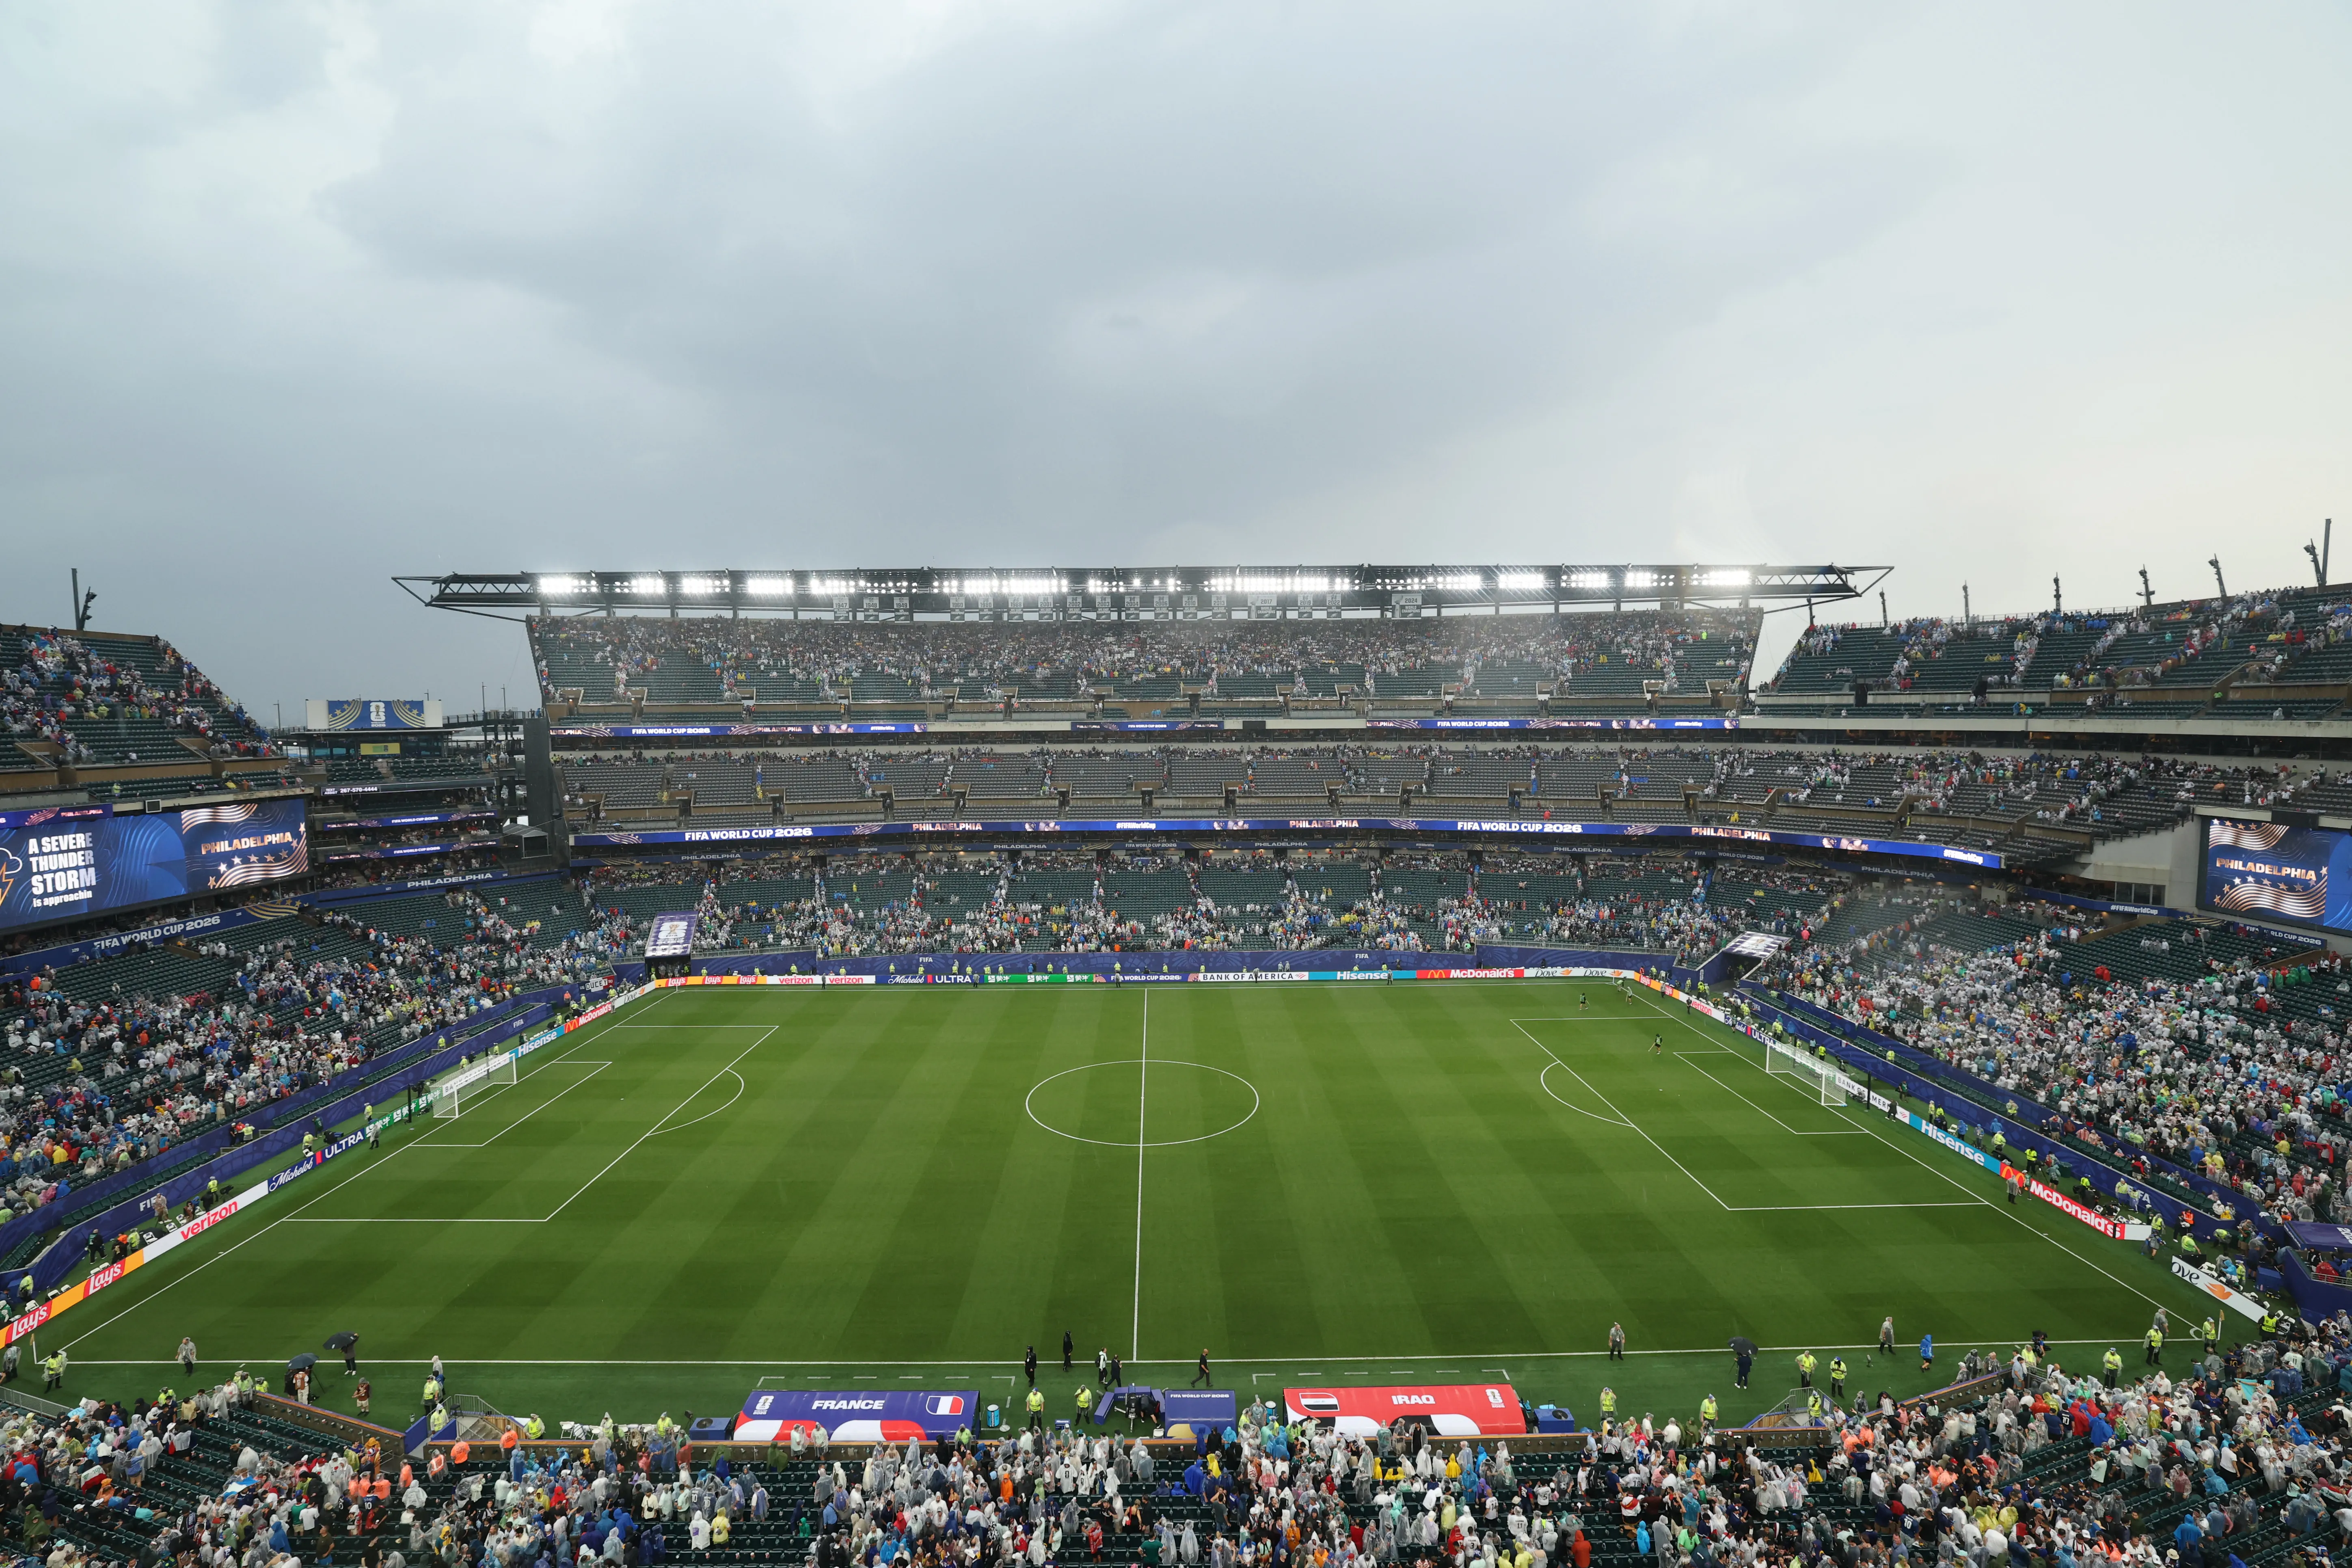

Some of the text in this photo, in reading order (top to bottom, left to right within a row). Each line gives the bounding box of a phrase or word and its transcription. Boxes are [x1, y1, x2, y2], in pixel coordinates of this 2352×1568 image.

[913, 823, 983, 831] PHILADELPHIA
[1116, 821, 1156, 830] #FIFAWorldCup
[1289, 820, 1359, 828] PHILADELPHIA
[1457, 821, 1582, 833] FIFA WORLD CUP 2026
[685, 827, 812, 841] FIFA WORLD CUP 2026
[1691, 827, 1771, 841] PHILADELPHIA
[28, 832, 93, 855] A SEVERE
[201, 832, 293, 855] PHILADELPHIA
[29, 850, 95, 873] THUNDER
[1862, 866, 1935, 879] PHILADELPHIA
[2216, 857, 2317, 881] PHILADELPHIA
[31, 867, 96, 895] STORM
[407, 873, 493, 888] PHILADELPHIA
[33, 890, 93, 907] is approachin
[2110, 904, 2158, 915] #FIFAWorldCup
[93, 916, 220, 950] FIFA WORLD CUP 2026
[2298, 936, 2322, 946] 2026
[1337, 971, 1388, 980] Hisense
[1449, 968, 1514, 978] McDonald's
[1584, 968, 1607, 976] Dove
[586, 979, 607, 989] DUCEY
[668, 977, 686, 986] Lay's
[705, 976, 721, 985] Lay's
[739, 976, 756, 984] Lay's
[888, 974, 924, 984] Michelob
[1640, 975, 1650, 986] Lay's
[1692, 1000, 1712, 1016] verizon
[579, 1003, 611, 1026] McDonald's
[513, 1019, 524, 1028] FIFA
[518, 1031, 557, 1058] Hisense
[1838, 1077, 1855, 1091] BANK
[1921, 1119, 1985, 1166] Hisense
[269, 1131, 364, 1192] Michelob ULTRA
[2030, 1180, 2121, 1238] McDonald's
[180, 1201, 238, 1240] verizon
[89, 1261, 122, 1295] Lay's
[11, 1305, 48, 1342] Lay's
[812, 1400, 886, 1410] FRANCE
[1391, 1395, 1436, 1405] IRAQ
[2062, 1416, 2070, 1425] 10
[691, 1494, 698, 1502] 10
[364, 1502, 372, 1510] 10
[1904, 1518, 1912, 1529] 10
